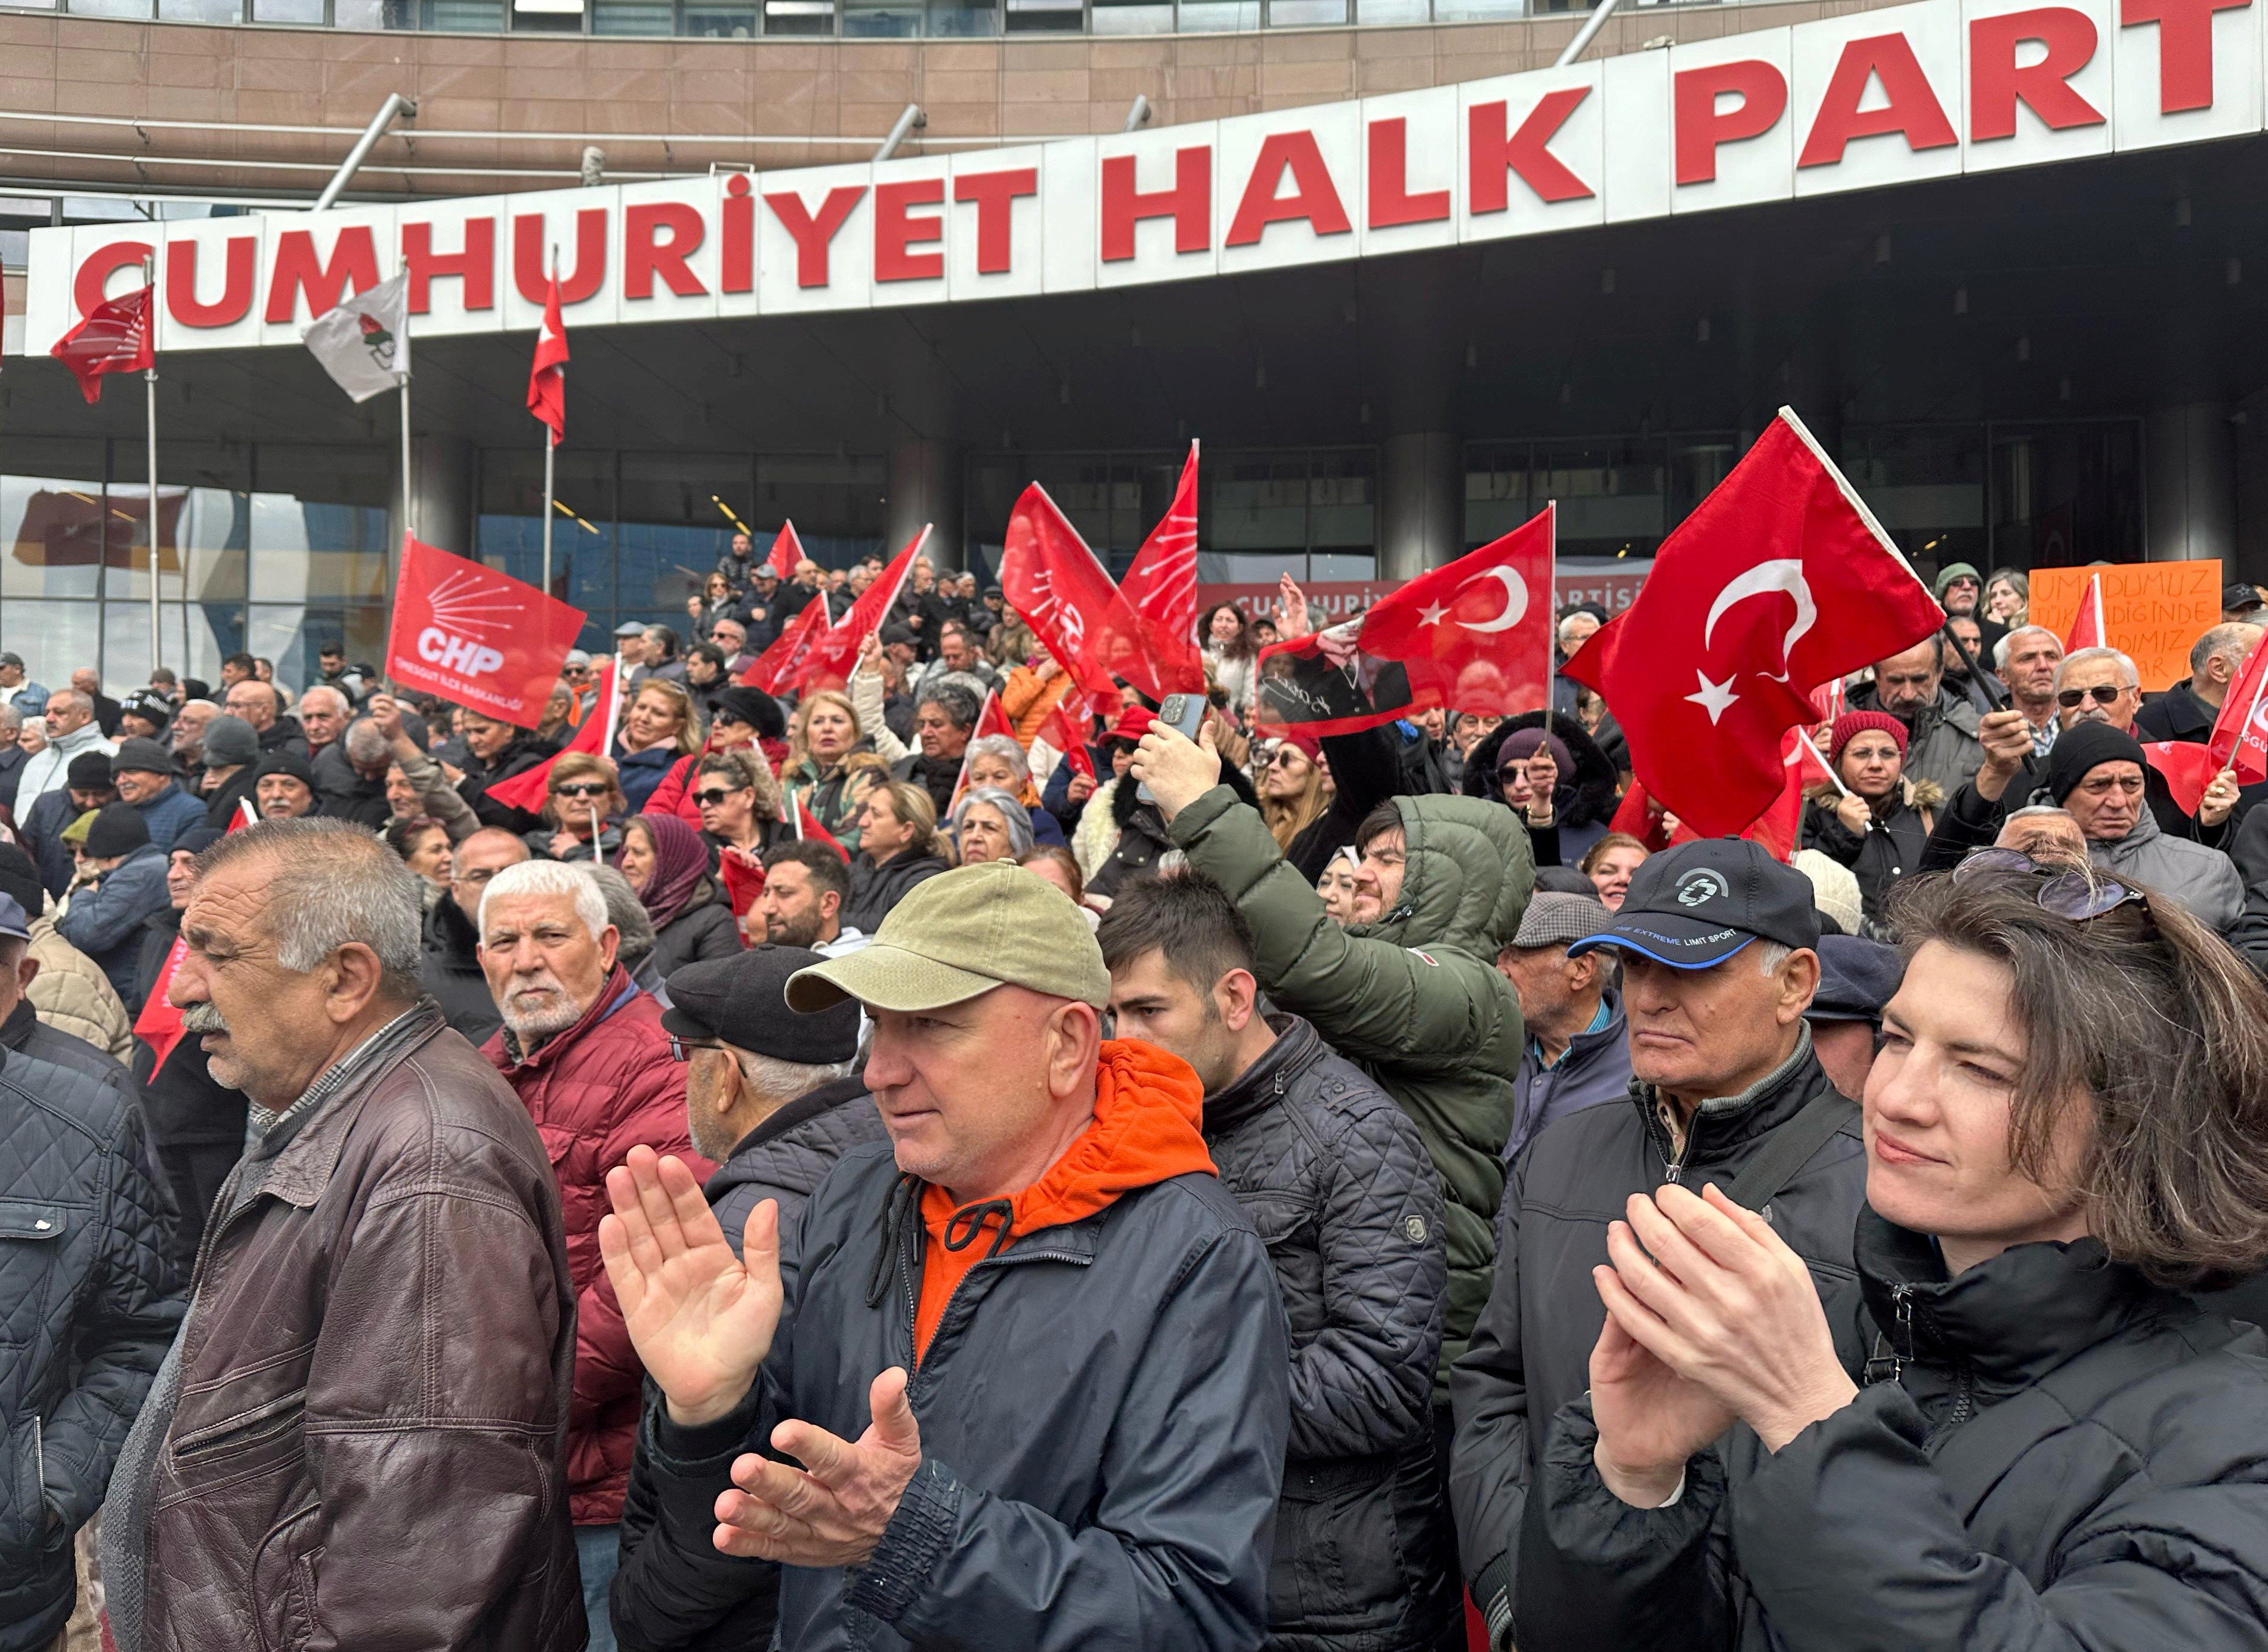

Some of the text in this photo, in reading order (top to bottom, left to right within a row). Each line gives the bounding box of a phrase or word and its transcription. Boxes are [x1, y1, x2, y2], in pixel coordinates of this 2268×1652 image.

[74, 0, 2253, 328] CUMHURİYET HALK PART
[2035, 569, 2212, 602] UMDUMUZ
[2033, 601, 2209, 629] TÜKDİĞİNDE
[418, 627, 504, 677] CHP
[2106, 629, 2189, 654] ADIMIZ
[2136, 656, 2169, 677] AR
[1633, 928, 1682, 946] EXTREME
[1683, 937, 1707, 947] LIMIT
[1708, 928, 1737, 943] SPORT
